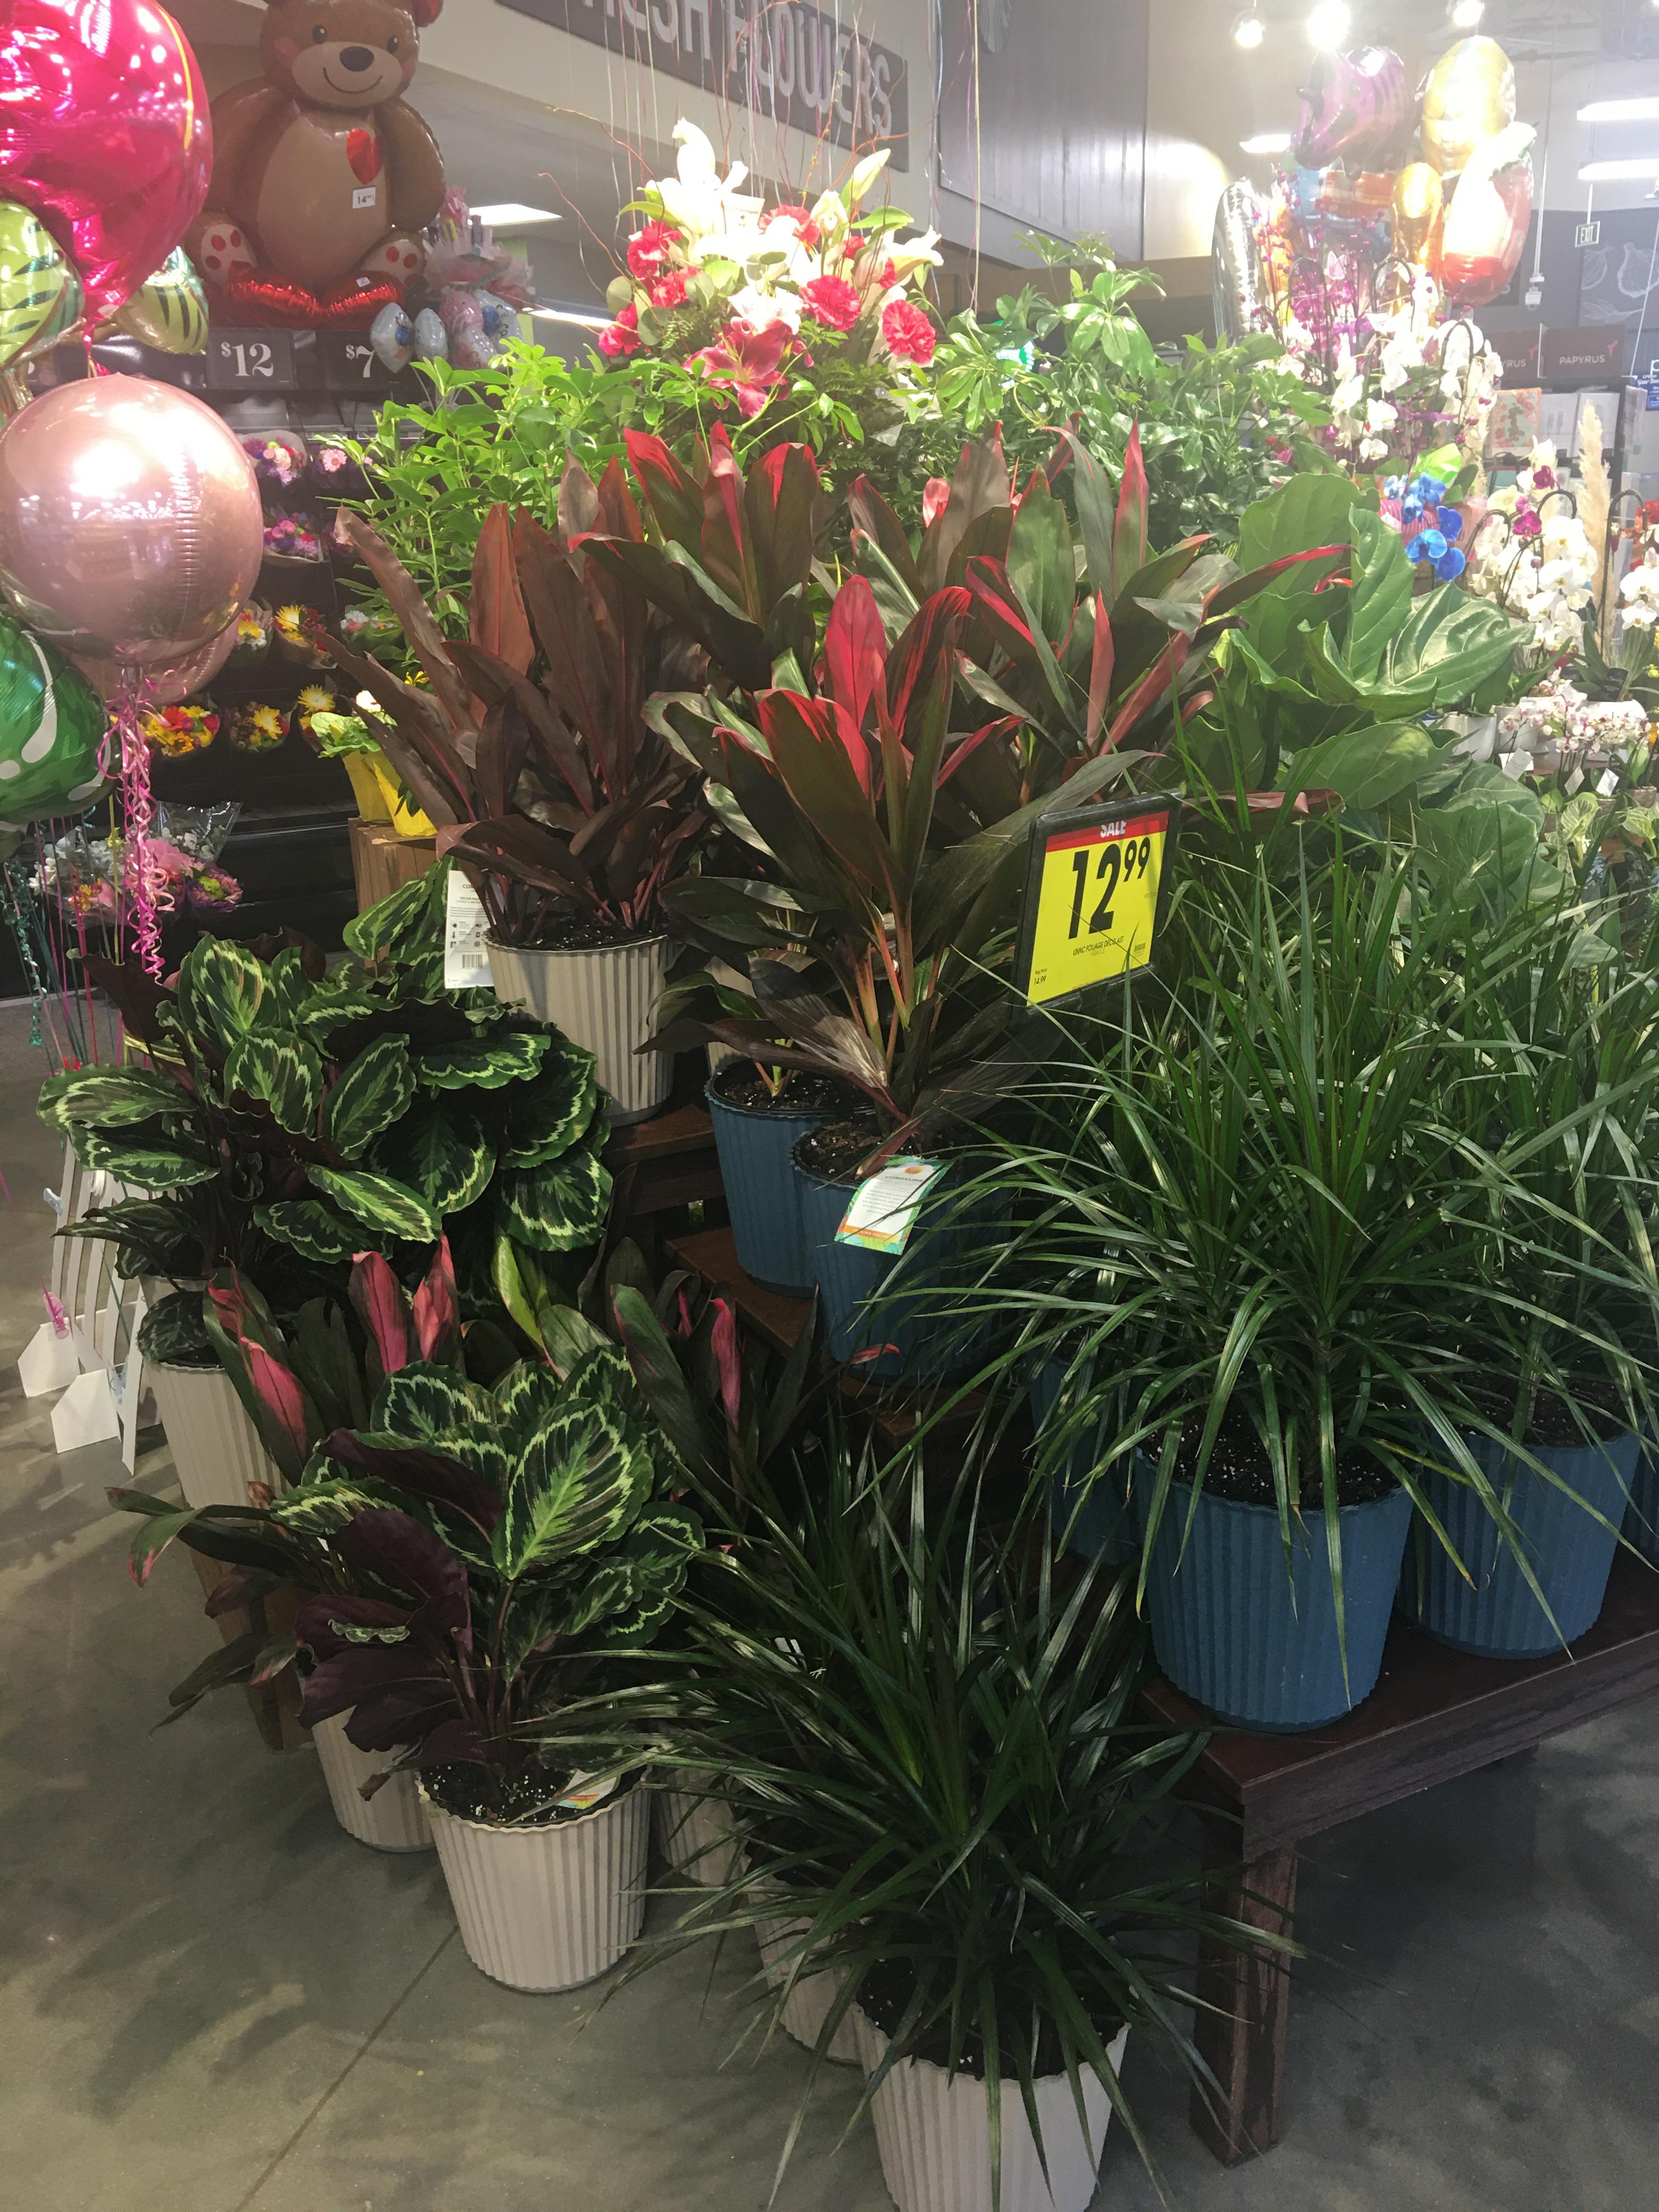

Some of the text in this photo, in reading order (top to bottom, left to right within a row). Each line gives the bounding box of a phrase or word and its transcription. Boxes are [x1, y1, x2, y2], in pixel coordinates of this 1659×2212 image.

[727, 0, 892, 141] FLOWERS
[1581, 225, 1594, 243] EXIT
[221, 341, 274, 377] $12
[1502, 359, 1527, 368] YRUS
[1559, 354, 1606, 365] PAPYRUS
[1100, 820, 1127, 838] SALE
